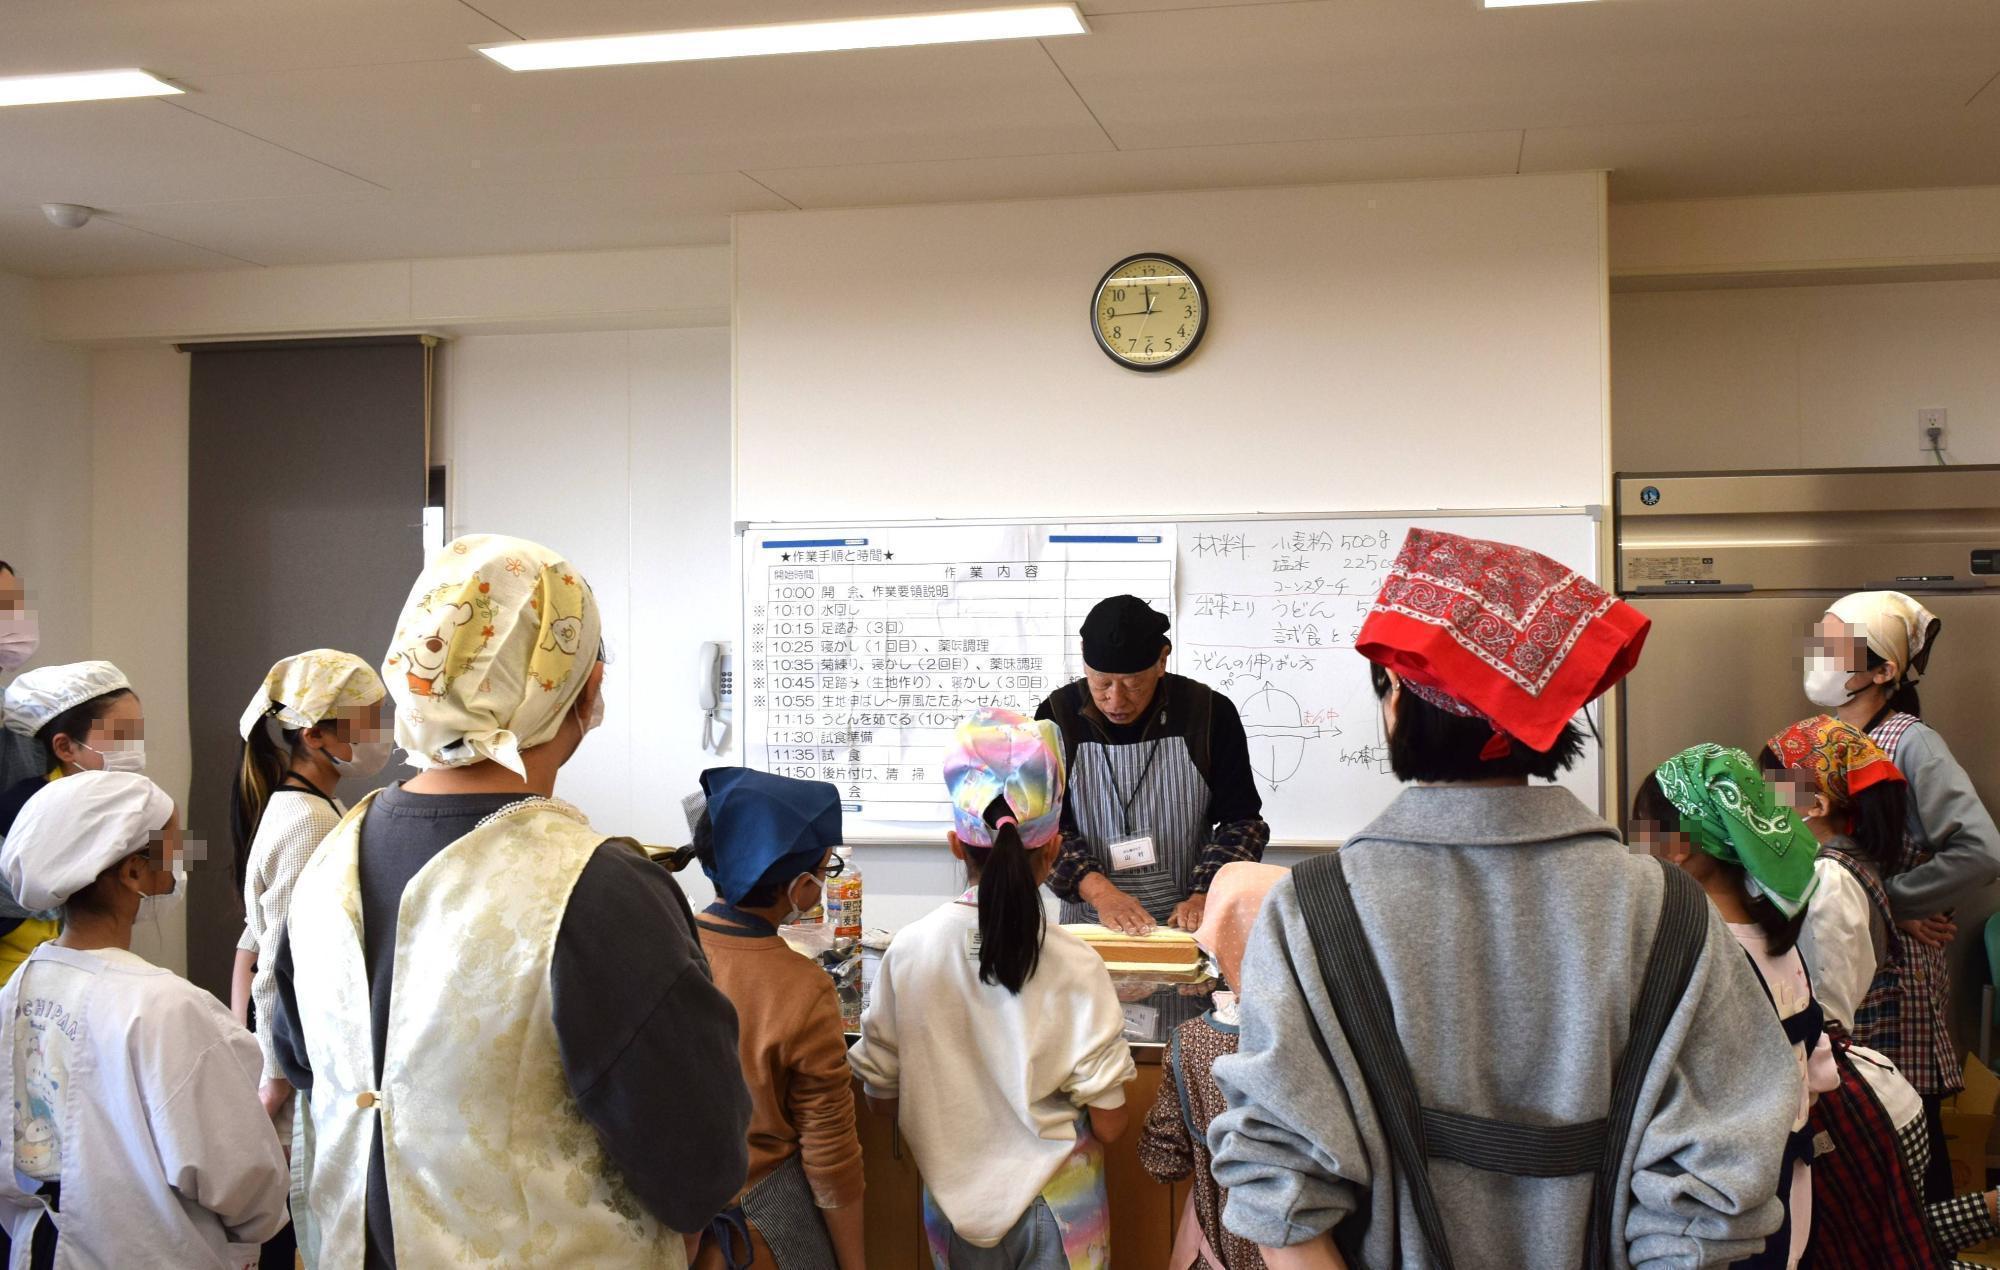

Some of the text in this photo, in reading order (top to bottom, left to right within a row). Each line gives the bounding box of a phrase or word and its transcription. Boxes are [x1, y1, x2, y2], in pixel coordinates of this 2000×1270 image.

[1112, 289, 1126, 302] 10
[1178, 287, 1187, 300] 2
[1106, 307, 1115, 320] 9
[1184, 305, 1193, 319] 3
[1112, 326, 1121, 339] 8
[1177, 324, 1185, 338] 4
[1128, 338, 1137, 352] 7
[1144, 343, 1154, 356] 6
[1164, 338, 1172, 351] 5
[1191, 532, 1256, 560] 材料
[1272, 530, 1334, 552] 小麦粉
[775, 587, 815, 599] 10:00
[774, 604, 814, 616] 10:10
[821, 603, 860, 616] 水回し
[1272, 600, 1335, 619] うどん
[773, 623, 814, 635] 10:15
[772, 641, 814, 653] 10:25
[772, 659, 814, 671] 10:35
[774, 676, 815, 689] 10:45
[775, 695, 815, 707] 10:55
[775, 713, 815, 725] 11:15
[773, 730, 873, 744] 11:30 試食準備
[774, 749, 815, 761] 11:35
[775, 767, 816, 779] 11:50
